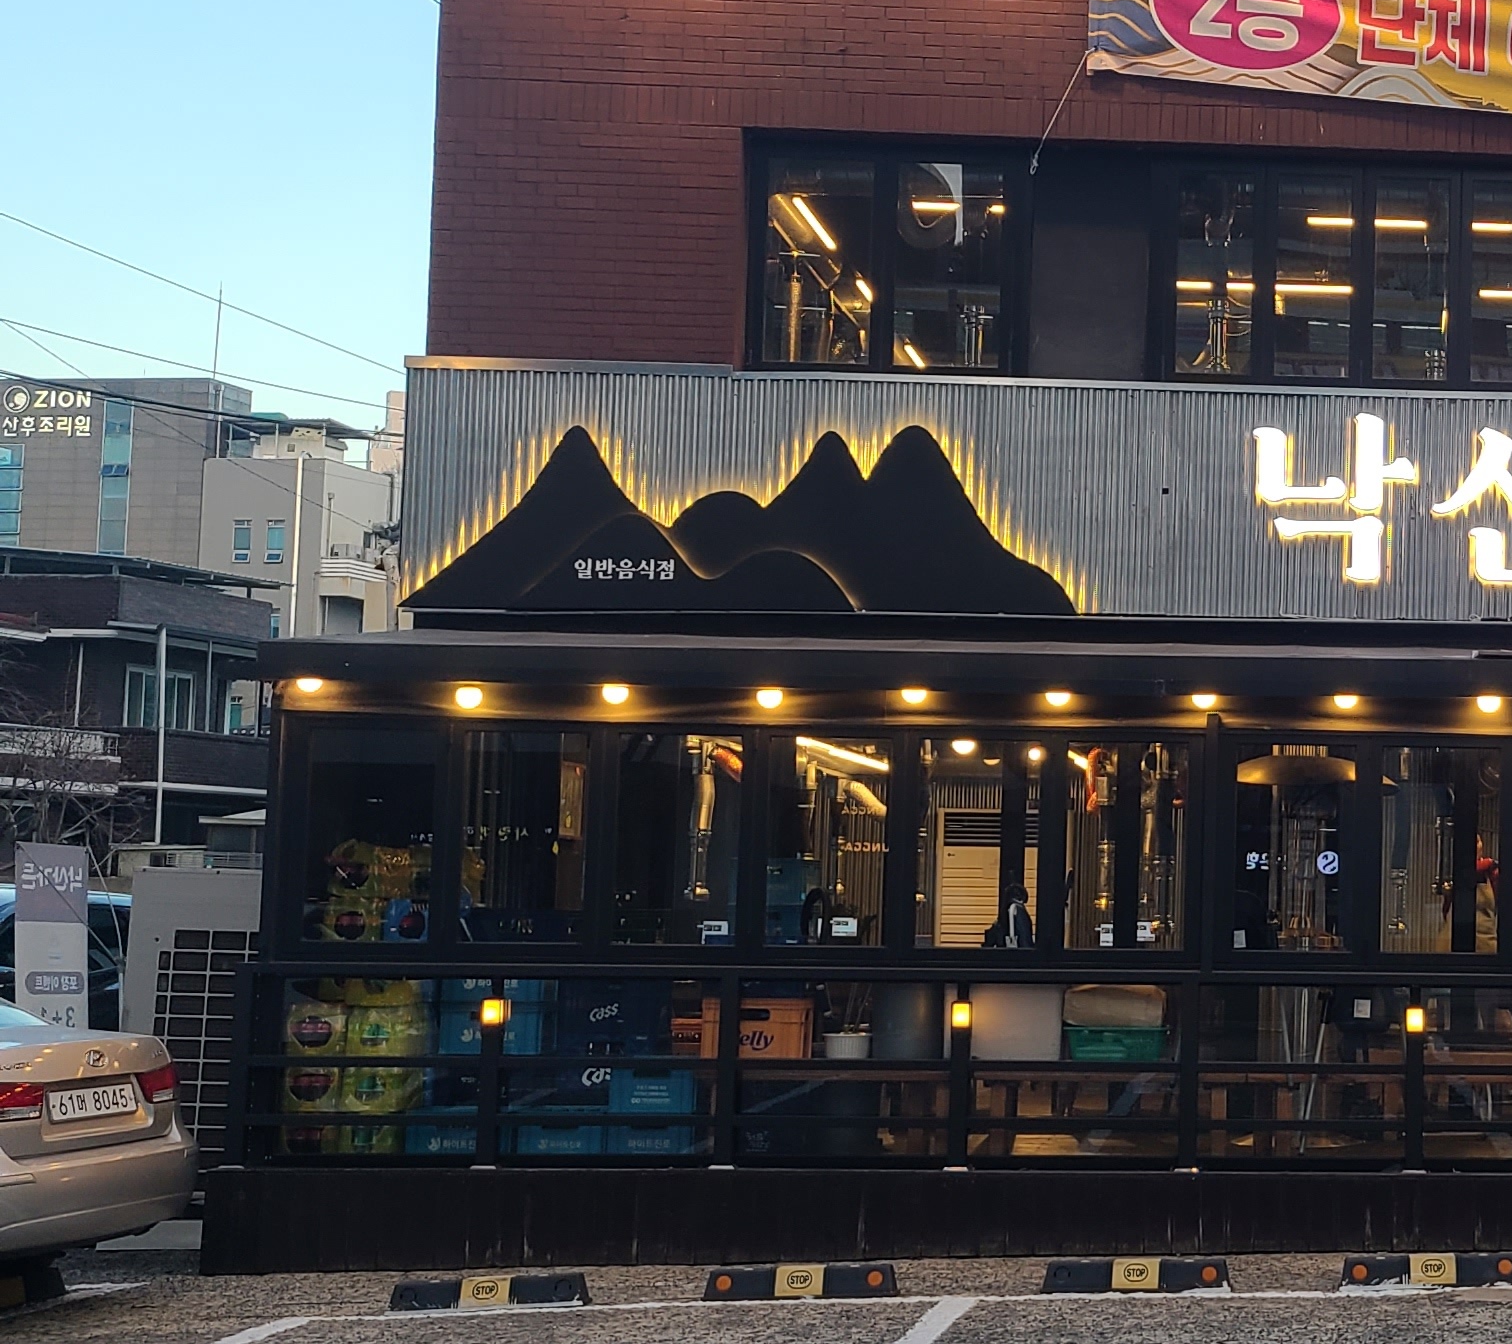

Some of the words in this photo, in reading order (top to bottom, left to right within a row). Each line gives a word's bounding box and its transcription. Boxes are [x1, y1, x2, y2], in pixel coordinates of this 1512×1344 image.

[33, 389, 92, 408] ZION
[2, 415, 92, 437] 산후조리원
[574, 558, 676, 580] 일반음식점
[740, 1030, 774, 1051] elly
[93, 1087, 128, 1112] 8045
[1126, 1267, 1145, 1277] STOP
[1424, 1263, 1443, 1273] STOP
[790, 1275, 809, 1285] STOP
[475, 1285, 495, 1295] STOP
